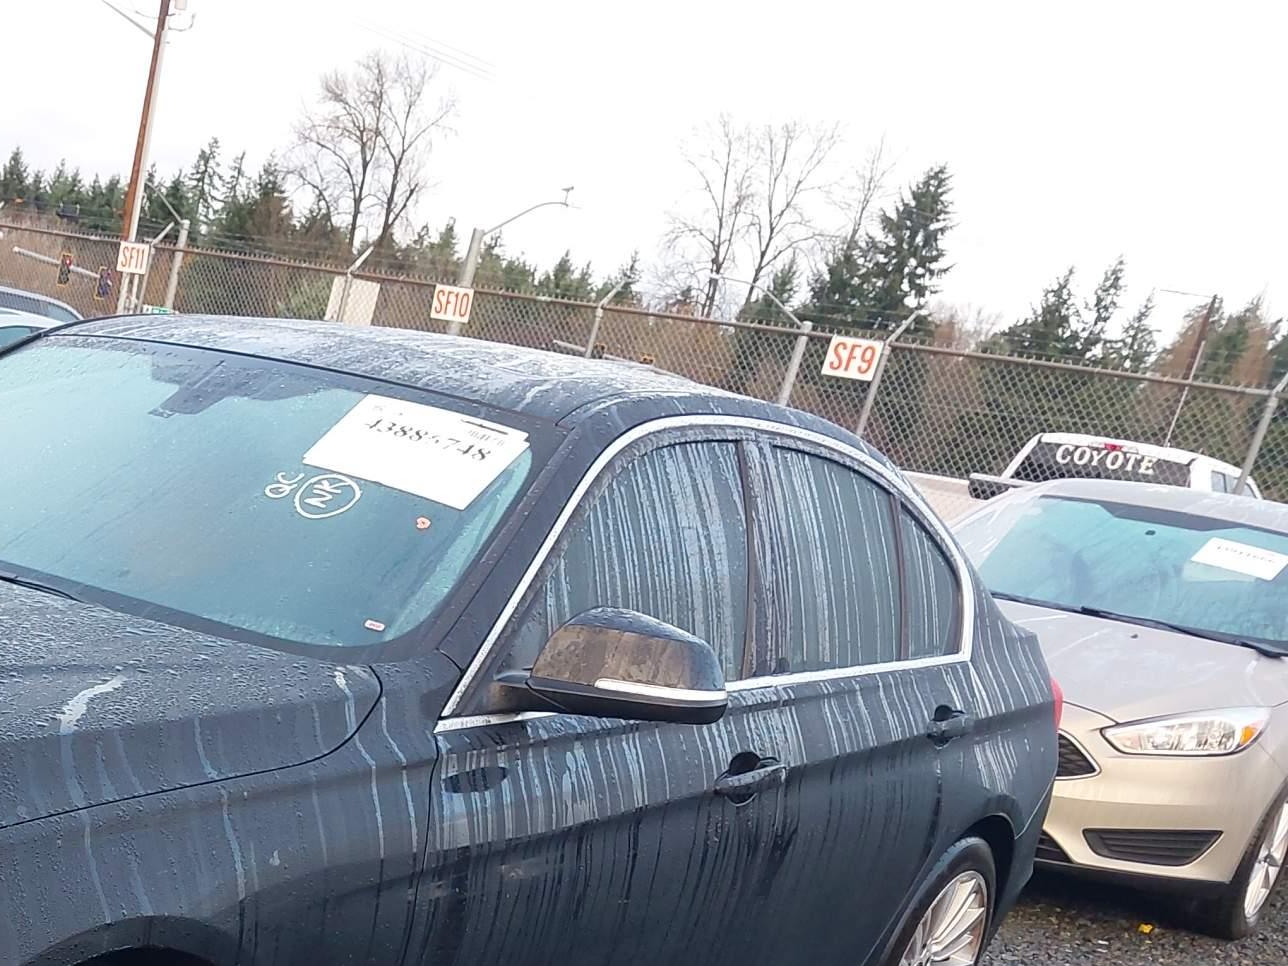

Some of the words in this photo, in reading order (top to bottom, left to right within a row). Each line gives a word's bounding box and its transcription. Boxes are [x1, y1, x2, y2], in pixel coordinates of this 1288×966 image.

[121, 246, 145, 271] SF11
[434, 289, 469, 317] SF10
[829, 342, 876, 374] SF9
[1055, 444, 1158, 475] COYOTE
[264, 471, 304, 498] QC
